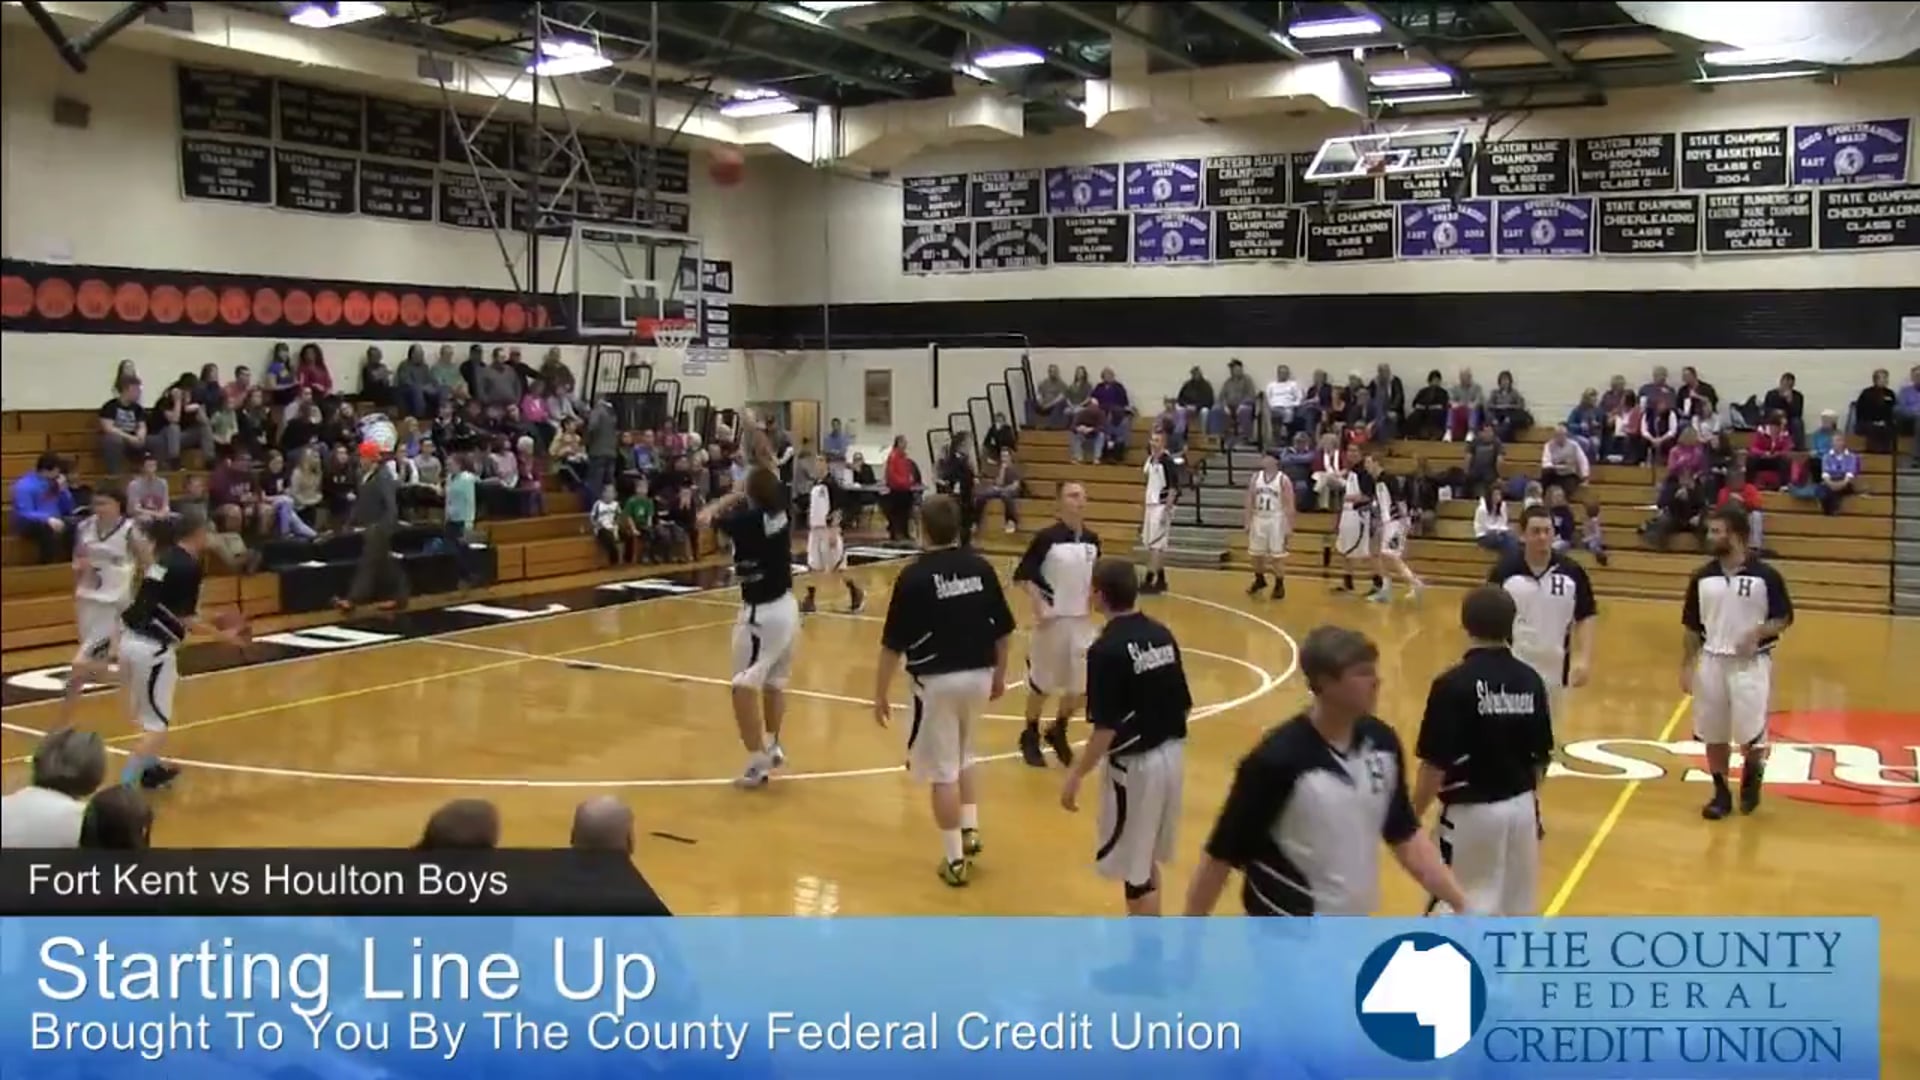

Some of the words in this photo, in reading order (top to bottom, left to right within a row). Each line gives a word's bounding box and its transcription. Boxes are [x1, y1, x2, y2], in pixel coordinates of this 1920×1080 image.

[1689, 135, 1721, 147] STATE
[1724, 132, 1781, 145] CHAMPIONS
[1492, 152, 1554, 165] CHAMPIONS
[1591, 147, 1660, 160] CHAMPIONS
[1685, 149, 1713, 161] BOYS
[1715, 145, 1783, 159] BASKETBALL
[1705, 161, 1749, 172] CLASS
[1752, 161, 1762, 170] C
[1801, 156, 1825, 168] EAST
[1599, 179, 1640, 189] CLASS
[1715, 174, 1751, 184] 2004
[1709, 196, 1740, 208] STATE
[1828, 193, 1865, 205] STATE
[1605, 201, 1635, 213] STATE
[1638, 200, 1692, 212] CHAMPIONS
[1337, 208, 1393, 223] CHAMPIONS
[1603, 213, 1696, 226] CHEERLEADING
[1846, 220, 1892, 231] CLASS
[1621, 227, 1662, 237] CLASS
[1725, 228, 1792, 239] SOFTBALL
[1731, 238, 1773, 249] CLASS
[1550, 575, 1565, 596] H
[1737, 578, 1752, 597] H
